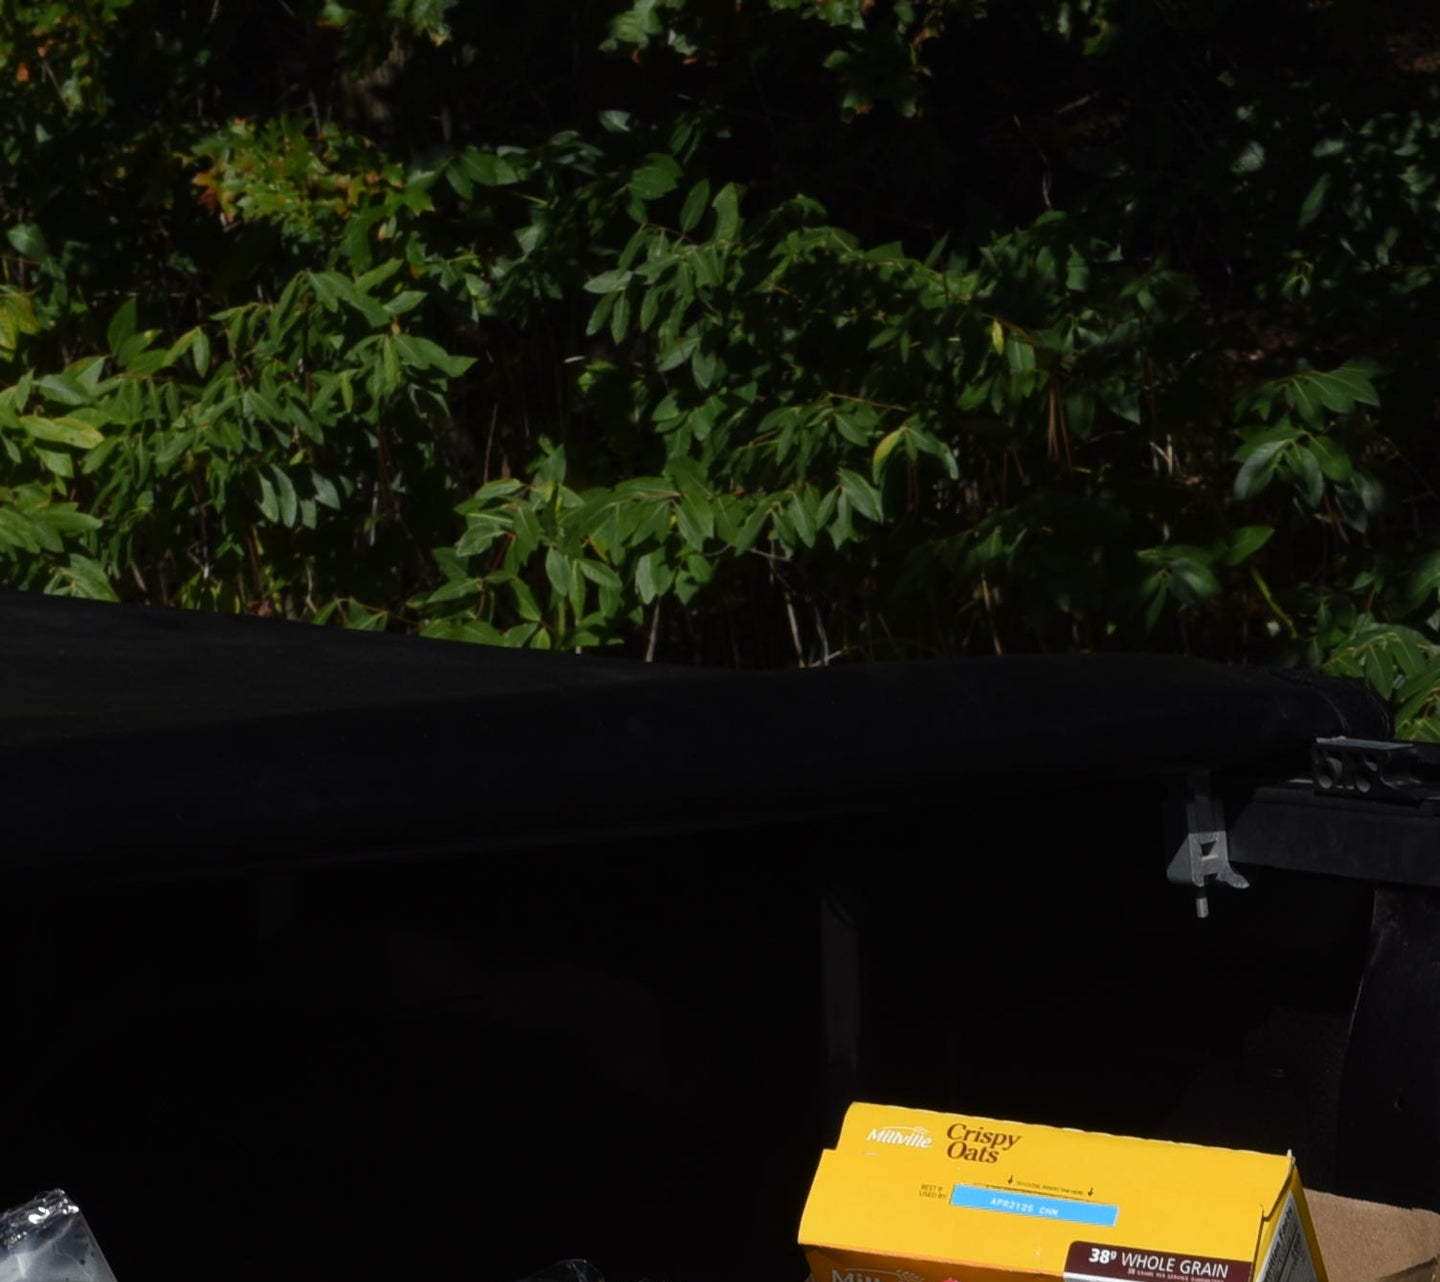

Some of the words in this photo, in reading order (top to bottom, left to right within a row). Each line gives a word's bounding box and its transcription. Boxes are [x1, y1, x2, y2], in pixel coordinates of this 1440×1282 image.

[867, 1128, 932, 1149] Millville
[947, 1123, 1021, 1151] Crispy
[947, 1140, 1000, 1164] Oats
[1121, 1252, 1176, 1273] WHOLE
[1179, 1260, 1229, 1279] GRAIN
